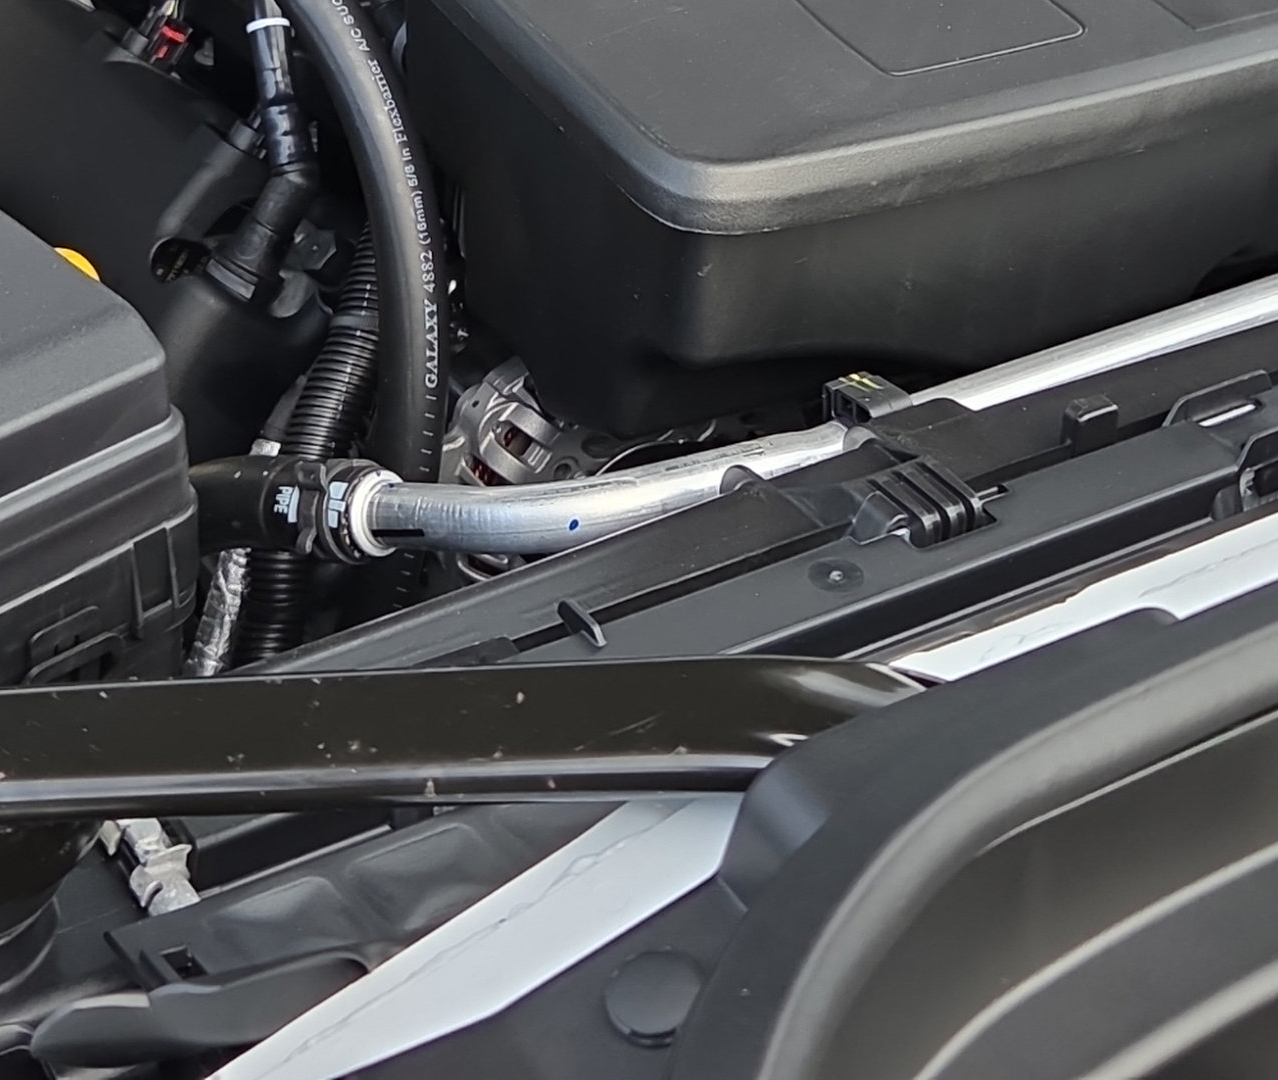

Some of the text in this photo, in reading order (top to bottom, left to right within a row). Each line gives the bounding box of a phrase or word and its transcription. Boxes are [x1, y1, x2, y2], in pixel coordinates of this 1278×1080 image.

[351, 27, 371, 52] A/C
[368, 58, 408, 144] Flexbarrier
[404, 164, 418, 187] 5/8
[411, 190, 431, 245] (16mm)
[420, 250, 435, 293] 4882
[424, 298, 439, 389] GALAXY
[273, 486, 294, 514] PIPE
